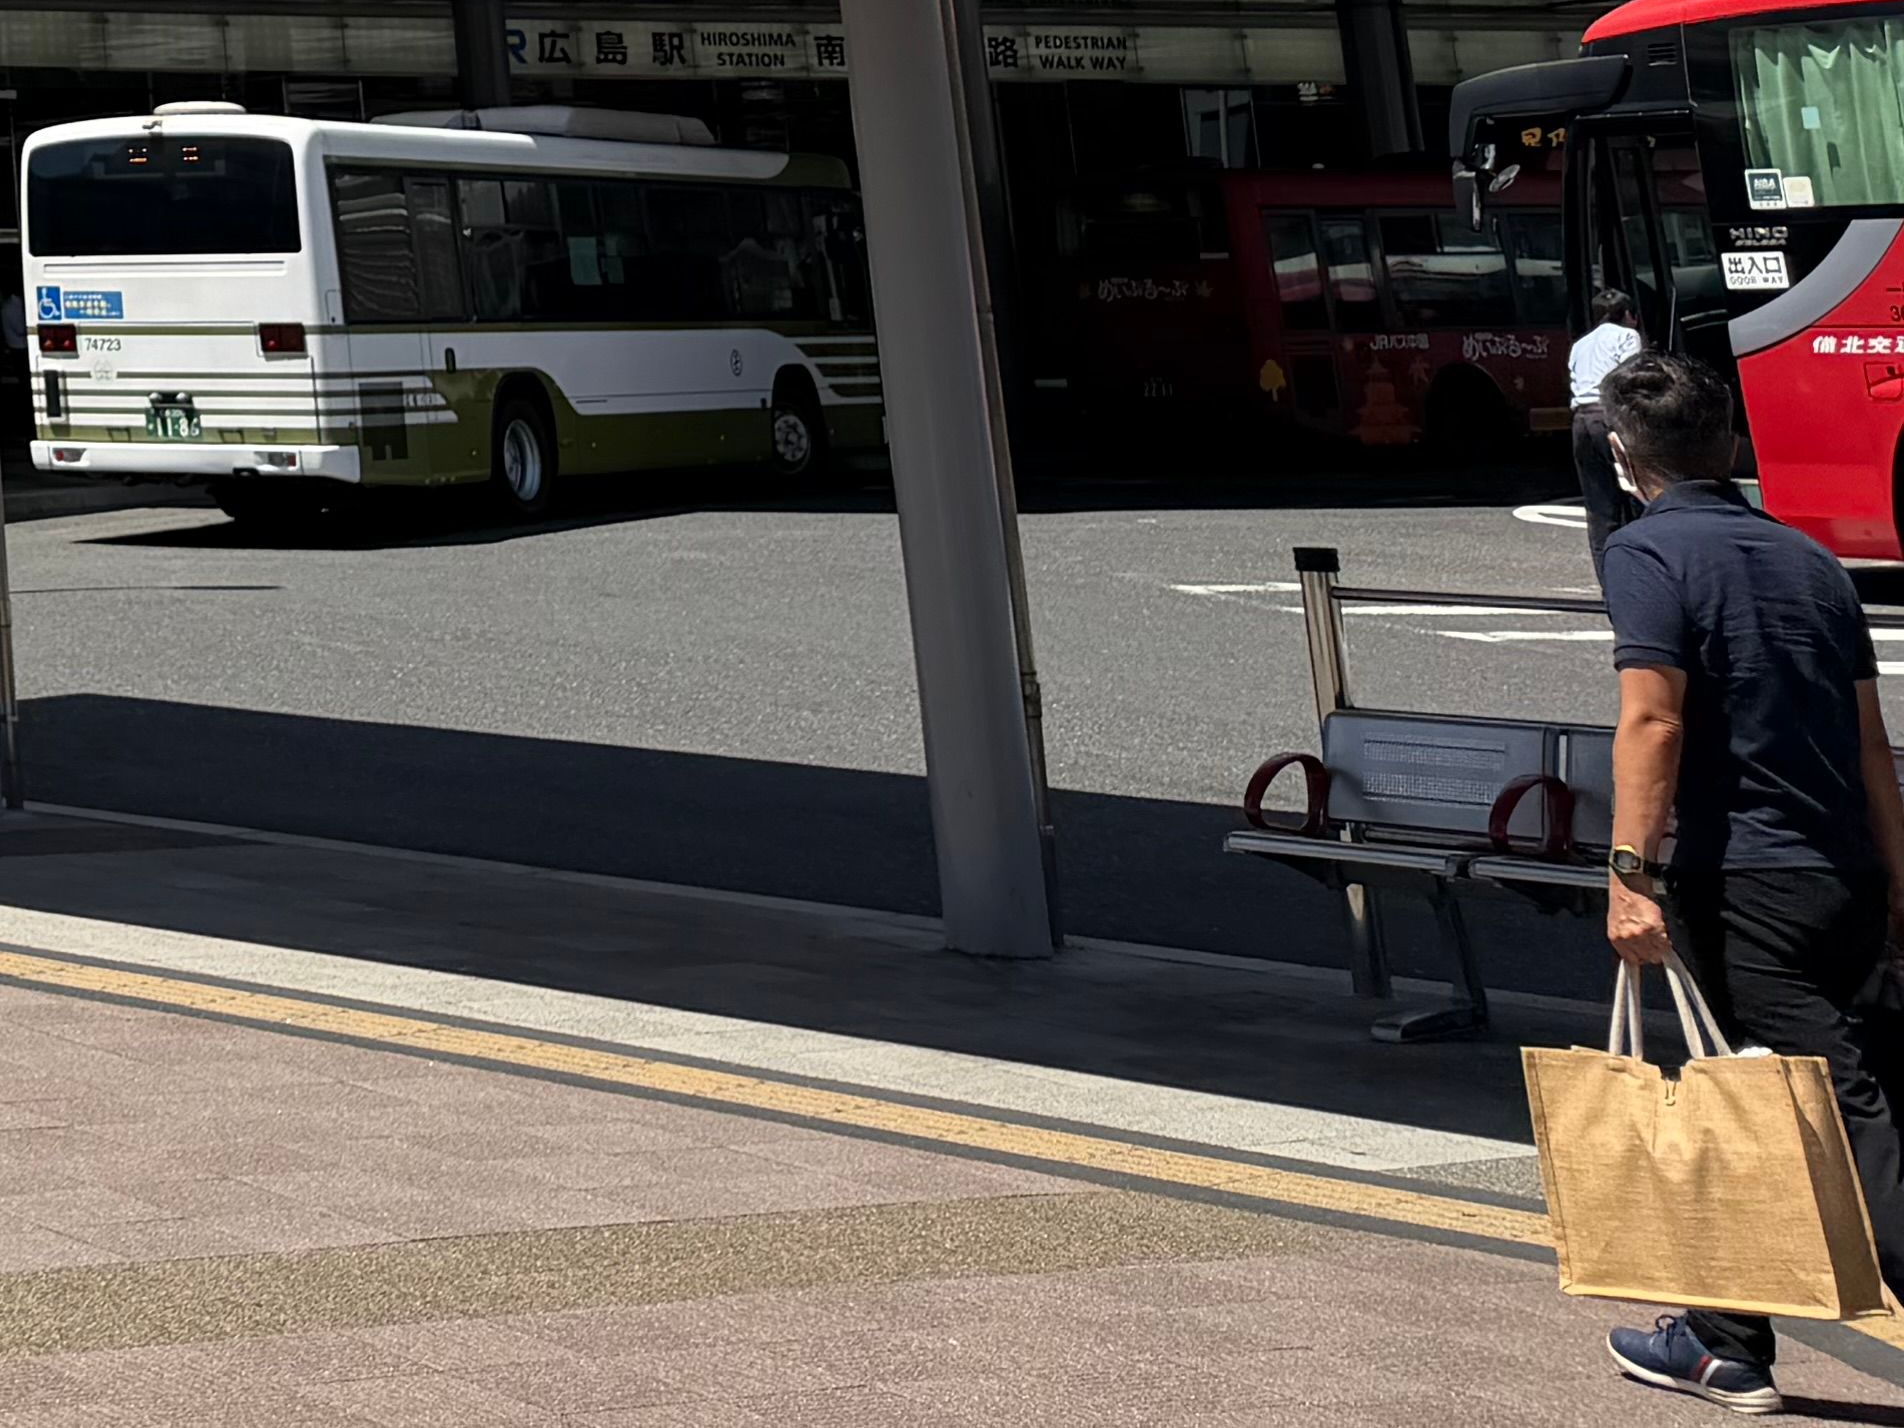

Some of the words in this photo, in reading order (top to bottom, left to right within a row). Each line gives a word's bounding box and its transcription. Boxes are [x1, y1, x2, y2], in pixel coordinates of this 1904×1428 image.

[700, 31, 796, 47] HIROSHIMA
[1034, 35, 1127, 50] PEDESTRIAN
[537, 30, 687, 66] 広島駅
[987, 36, 1019, 68] 路
[716, 52, 787, 68] STATION
[1039, 55, 1085, 70] WALK
[1090, 56, 1127, 71] WAY
[1728, 226, 1788, 239] HINO
[1728, 255, 1783, 275] 出入口
[84, 337, 122, 352] 74723
